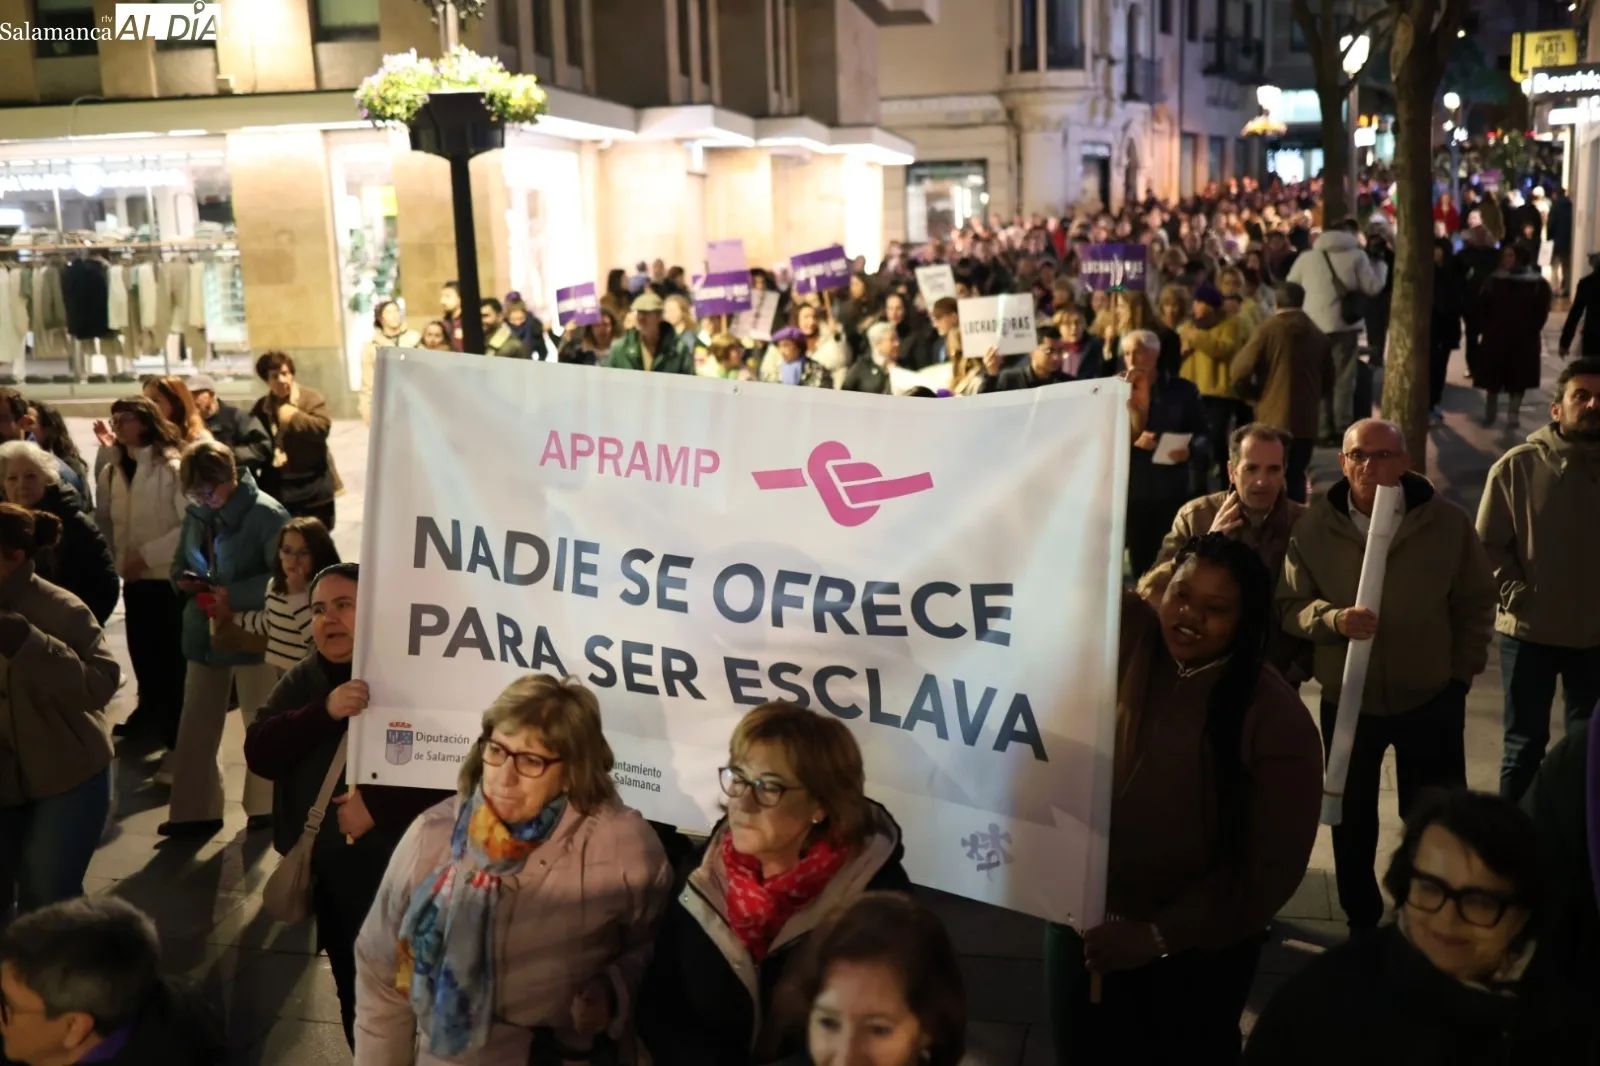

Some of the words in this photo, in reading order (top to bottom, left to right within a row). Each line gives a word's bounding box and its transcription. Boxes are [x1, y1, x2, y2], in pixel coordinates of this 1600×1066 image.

[1533, 70, 1600, 94] Bershk
[539, 430, 720, 488] APRAMP
[413, 516, 600, 598] NADIE
[619, 548, 694, 613] SE
[713, 562, 1014, 647] OFRECE
[407, 603, 568, 677] PARA
[583, 635, 707, 700] SER
[724, 656, 1049, 763] ESCLAVA
[416, 731, 470, 744] Diputación
[414, 752, 424, 760] de
[614, 772, 661, 793] Salamanca
